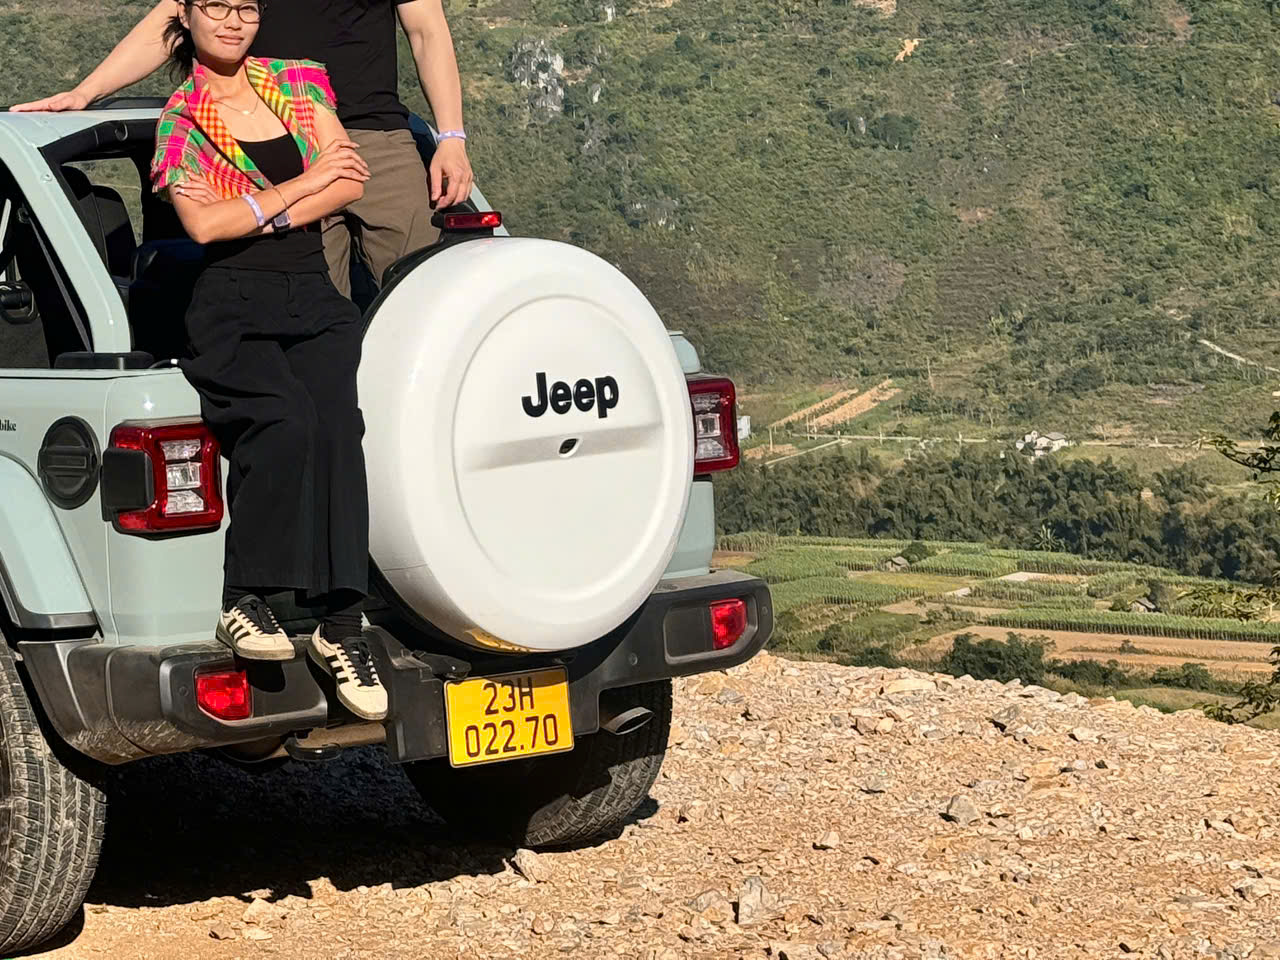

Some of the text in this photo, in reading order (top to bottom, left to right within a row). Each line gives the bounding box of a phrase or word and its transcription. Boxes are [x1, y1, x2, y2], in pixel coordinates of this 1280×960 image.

[521, 372, 619, 419] Jeep
[482, 676, 535, 716] 23H
[465, 713, 558, 758] 022.70
